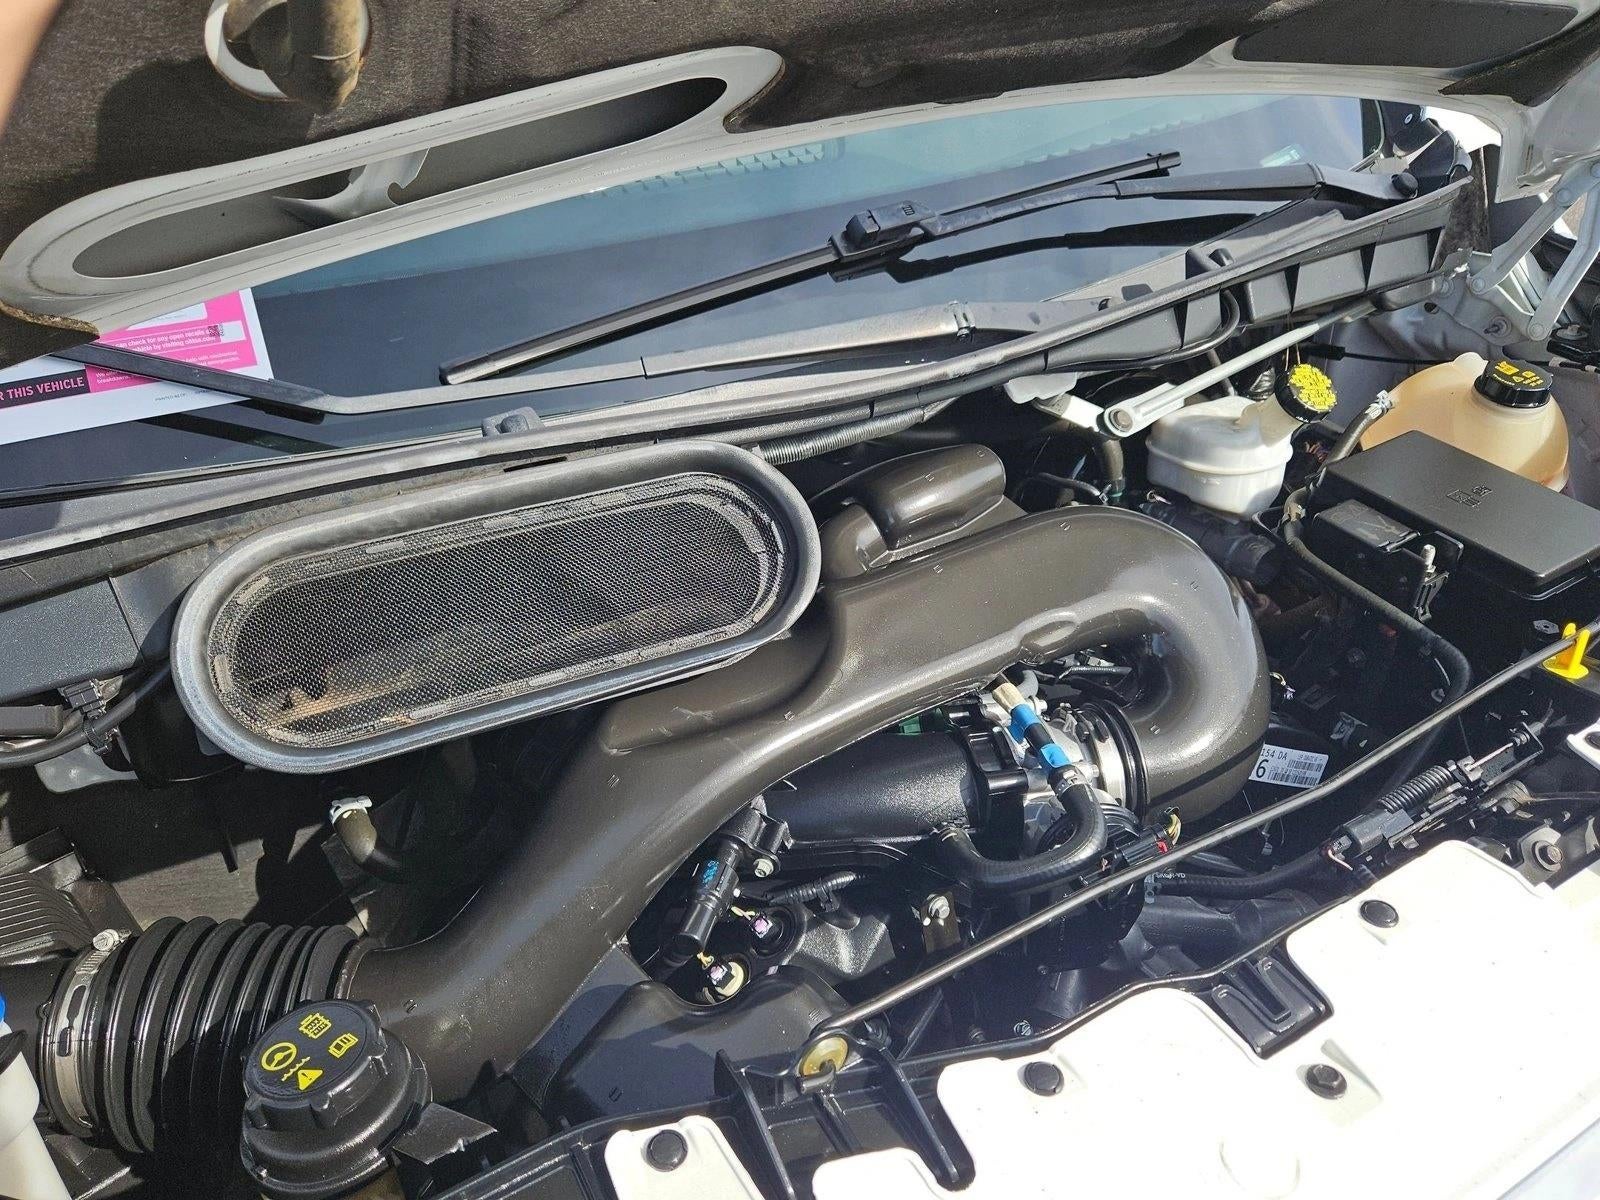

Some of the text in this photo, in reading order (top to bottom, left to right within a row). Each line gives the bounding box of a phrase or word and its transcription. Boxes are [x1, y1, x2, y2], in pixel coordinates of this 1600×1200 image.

[128, 339, 147, 347] check
[7, 385, 34, 399] THIS
[36, 376, 85, 394] VEHICLE
[1256, 758, 1269, 779] 6
